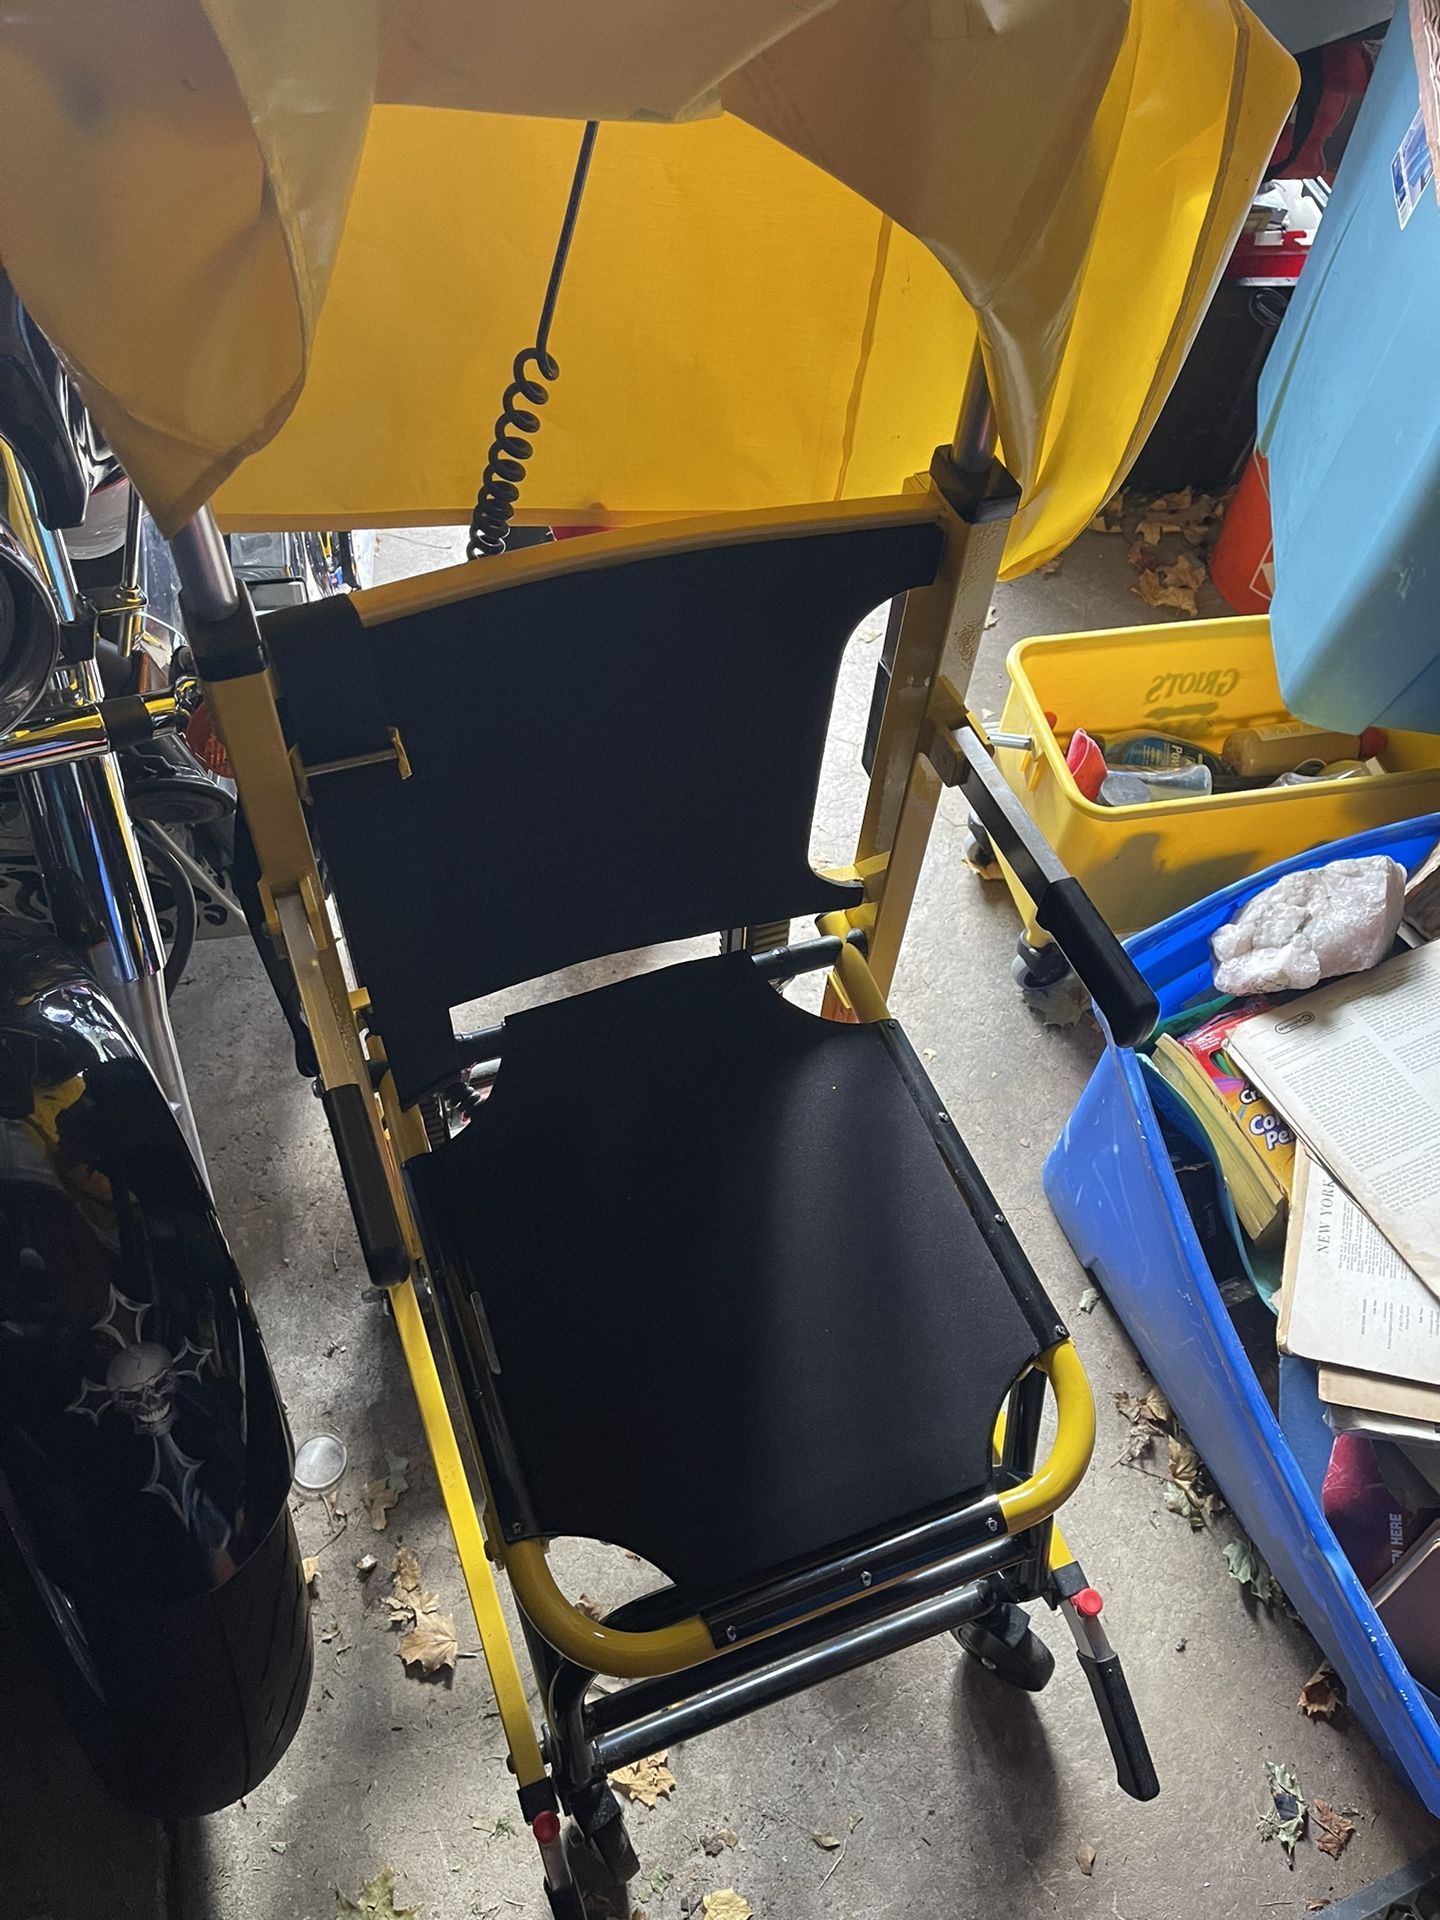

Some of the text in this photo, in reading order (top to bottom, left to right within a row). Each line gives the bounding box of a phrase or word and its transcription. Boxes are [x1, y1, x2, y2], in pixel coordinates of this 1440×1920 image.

[1316, 1179, 1335, 1254] NEW YORK
[1389, 1513, 1403, 1546] HERE
